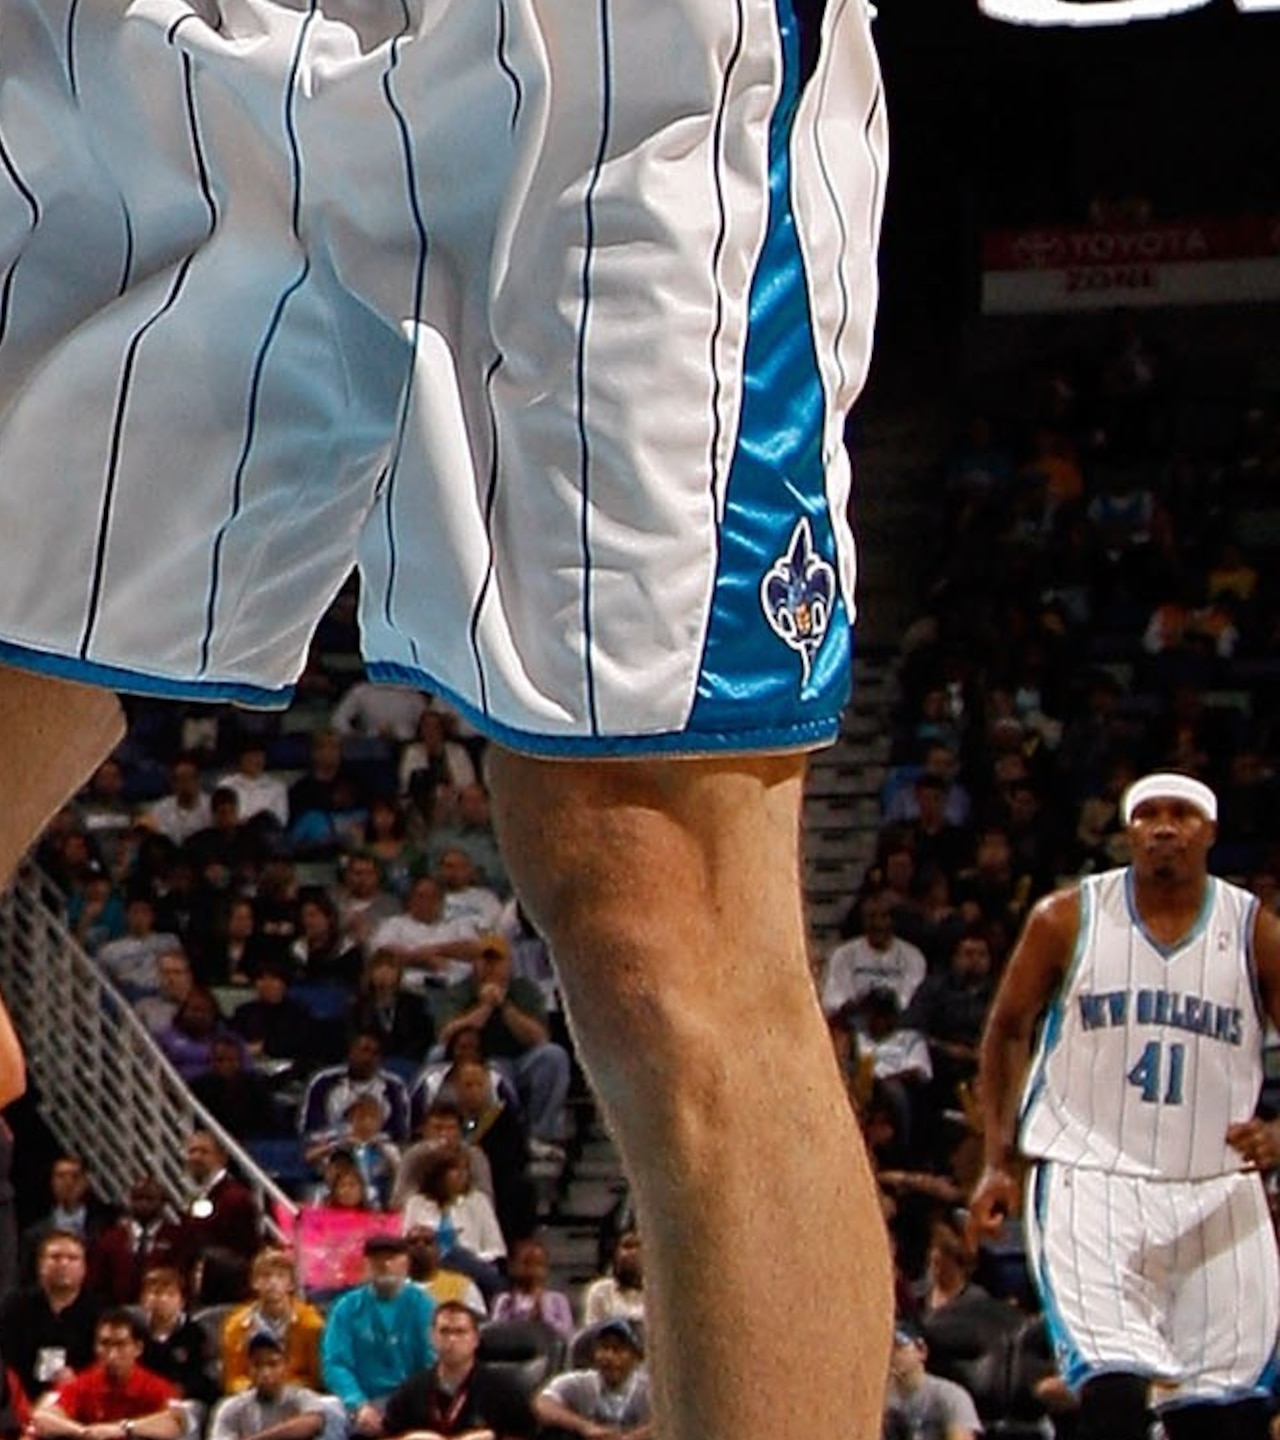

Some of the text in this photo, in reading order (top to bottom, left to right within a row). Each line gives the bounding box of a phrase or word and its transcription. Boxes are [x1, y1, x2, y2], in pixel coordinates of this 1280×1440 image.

[1070, 228, 1208, 259] TOYOTA
[1136, 988, 1243, 1046] ORLEANS
[1128, 1040, 1184, 1105] 41
